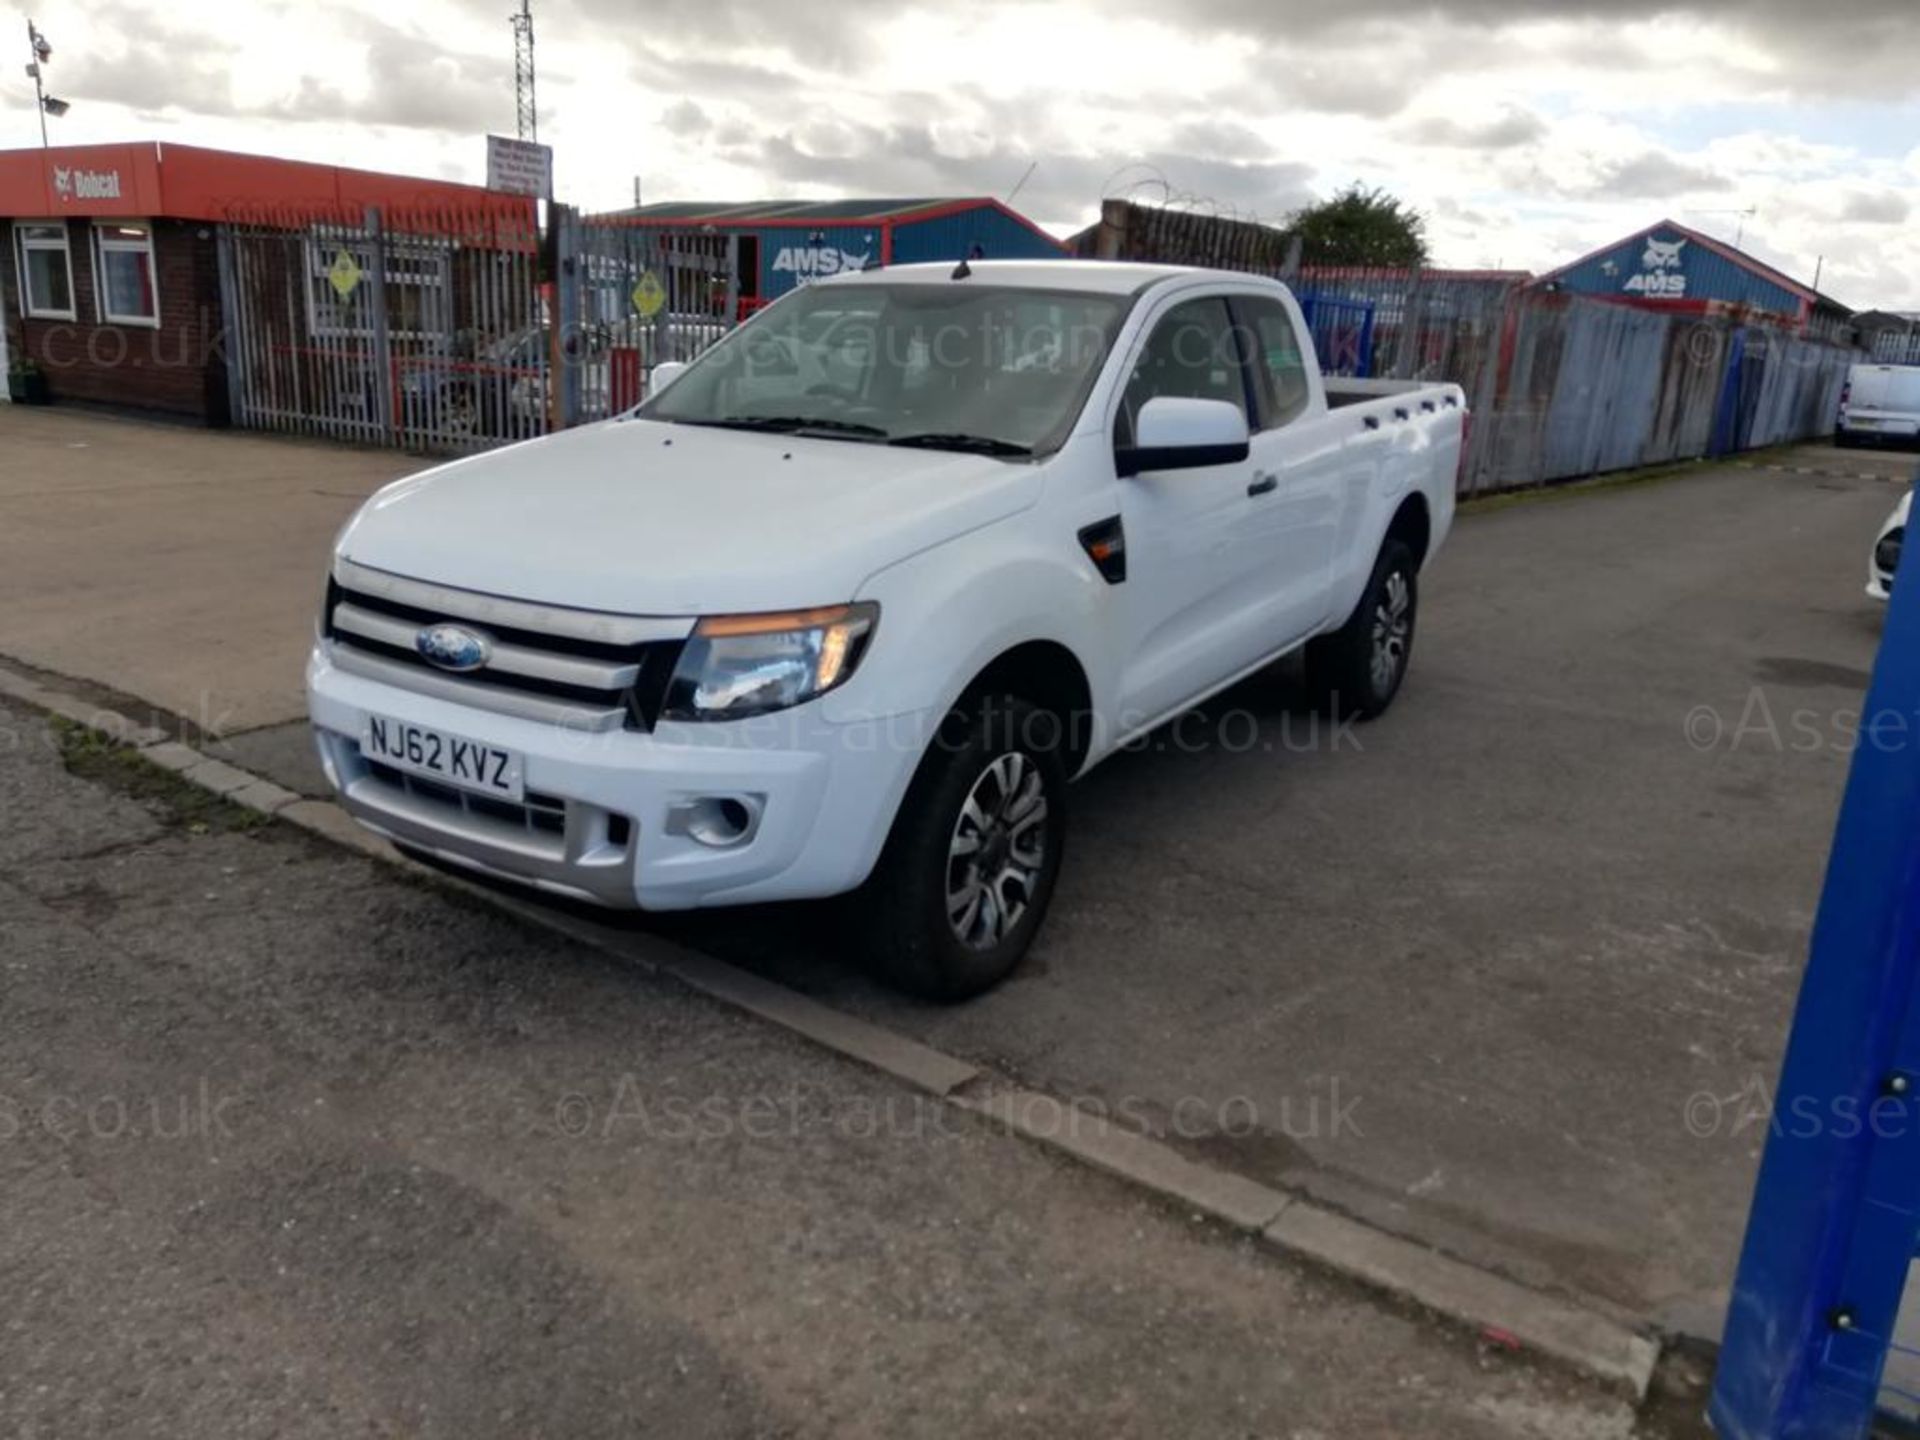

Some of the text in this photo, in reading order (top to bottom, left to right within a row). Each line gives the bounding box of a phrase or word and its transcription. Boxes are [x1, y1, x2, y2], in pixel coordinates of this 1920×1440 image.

[74, 169, 121, 198] Bobcat
[772, 247, 840, 274] AMS
[1622, 274, 1687, 292] AMS
[370, 716, 510, 790] NJ62 KVZ
